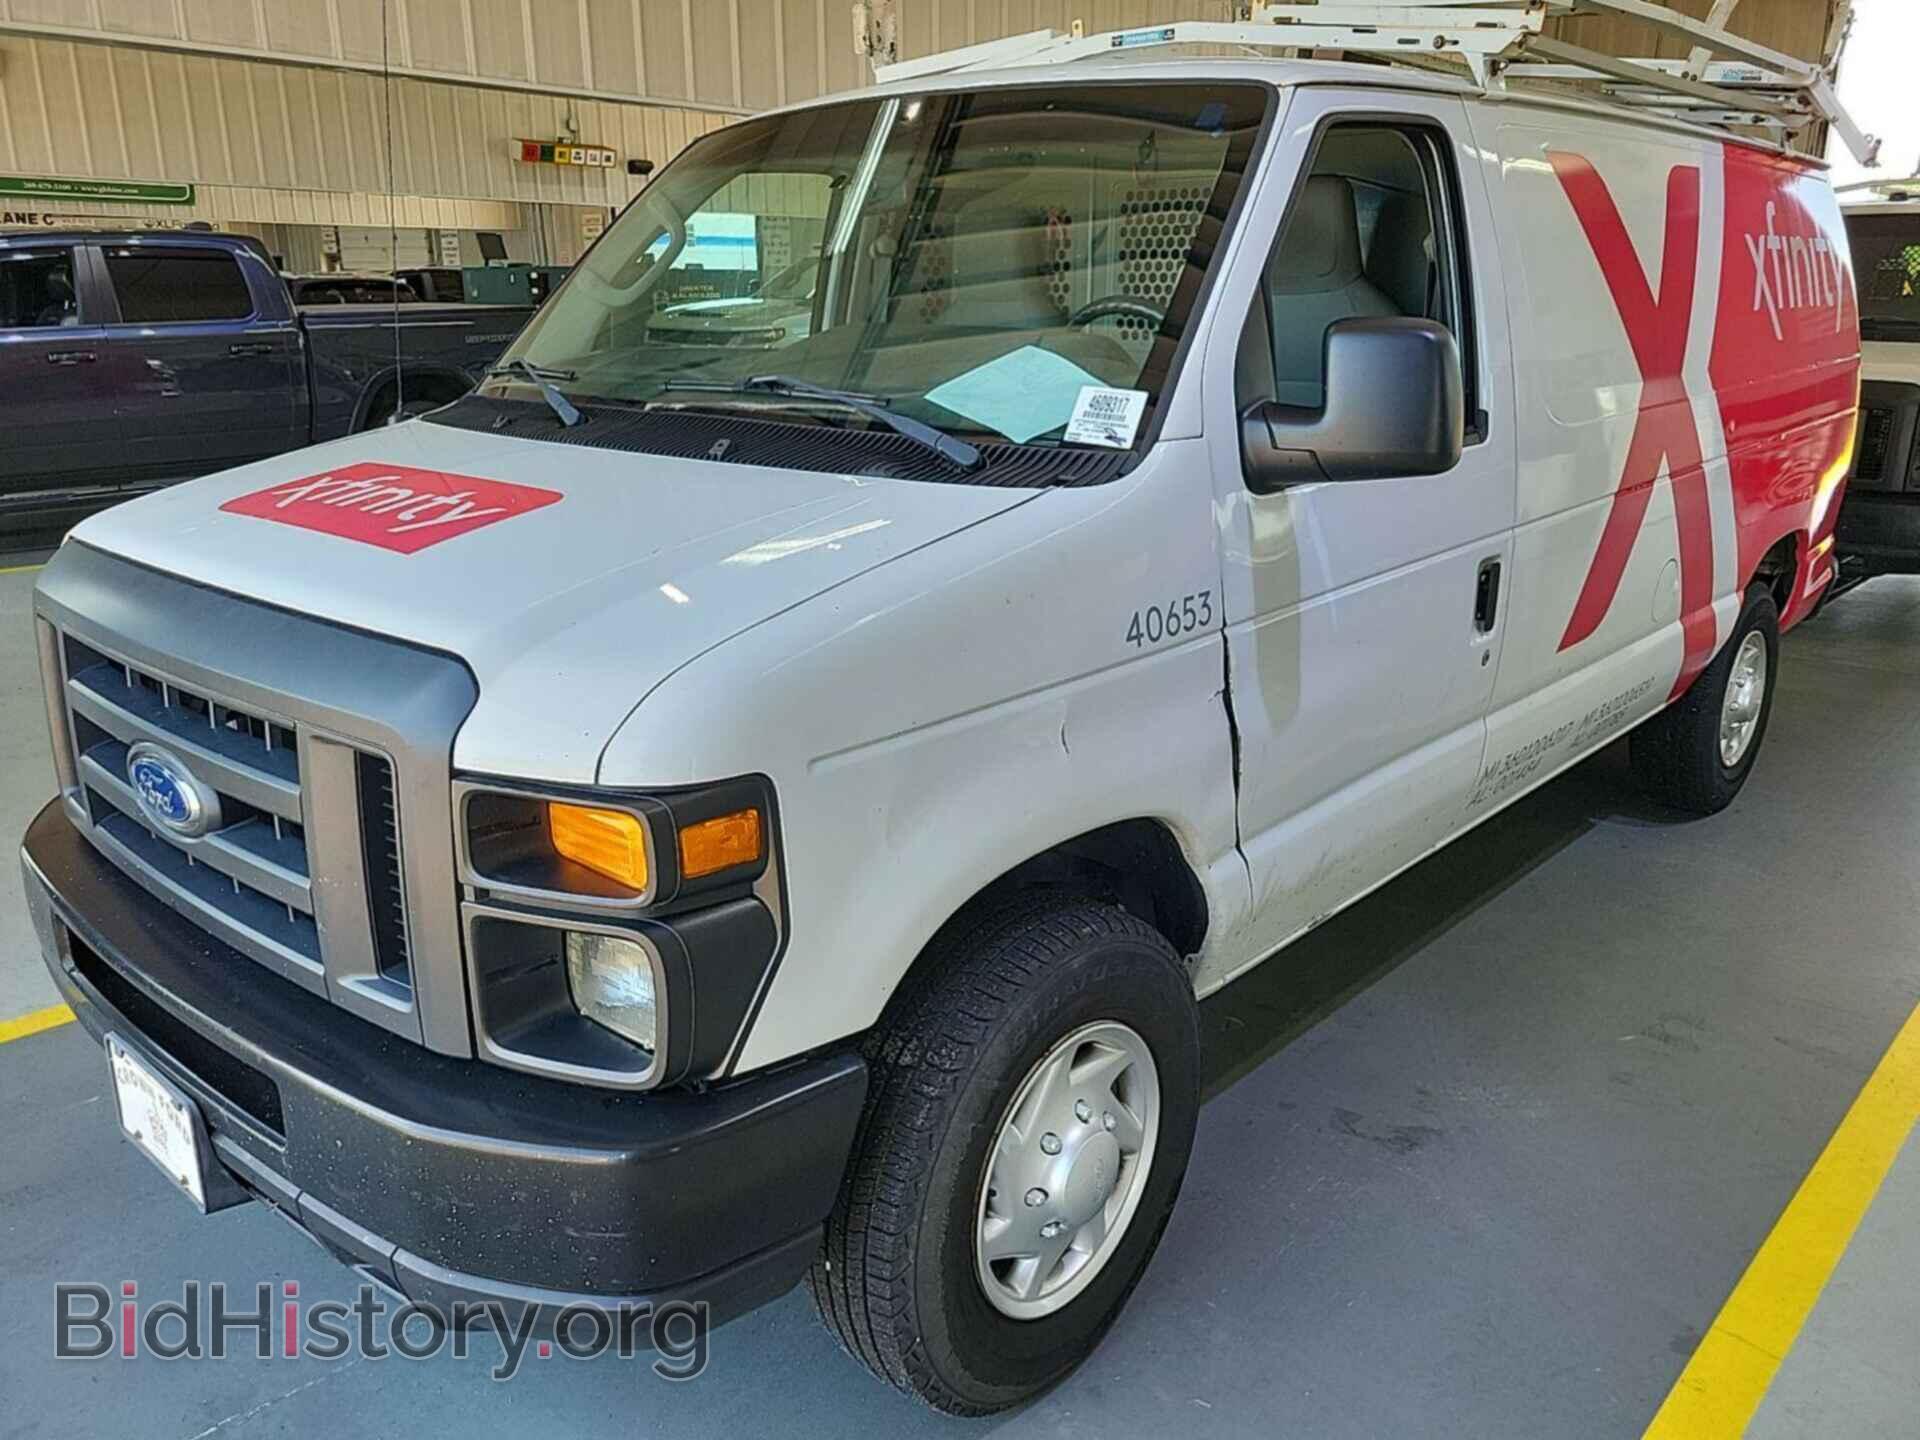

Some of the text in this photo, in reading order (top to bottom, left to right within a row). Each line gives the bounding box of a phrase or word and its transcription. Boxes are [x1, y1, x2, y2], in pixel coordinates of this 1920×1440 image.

[0, 211, 37, 225] ANE
[1744, 200, 1846, 342] xfinity
[271, 475, 507, 533] xfinity
[1125, 589, 1212, 648] 40653
